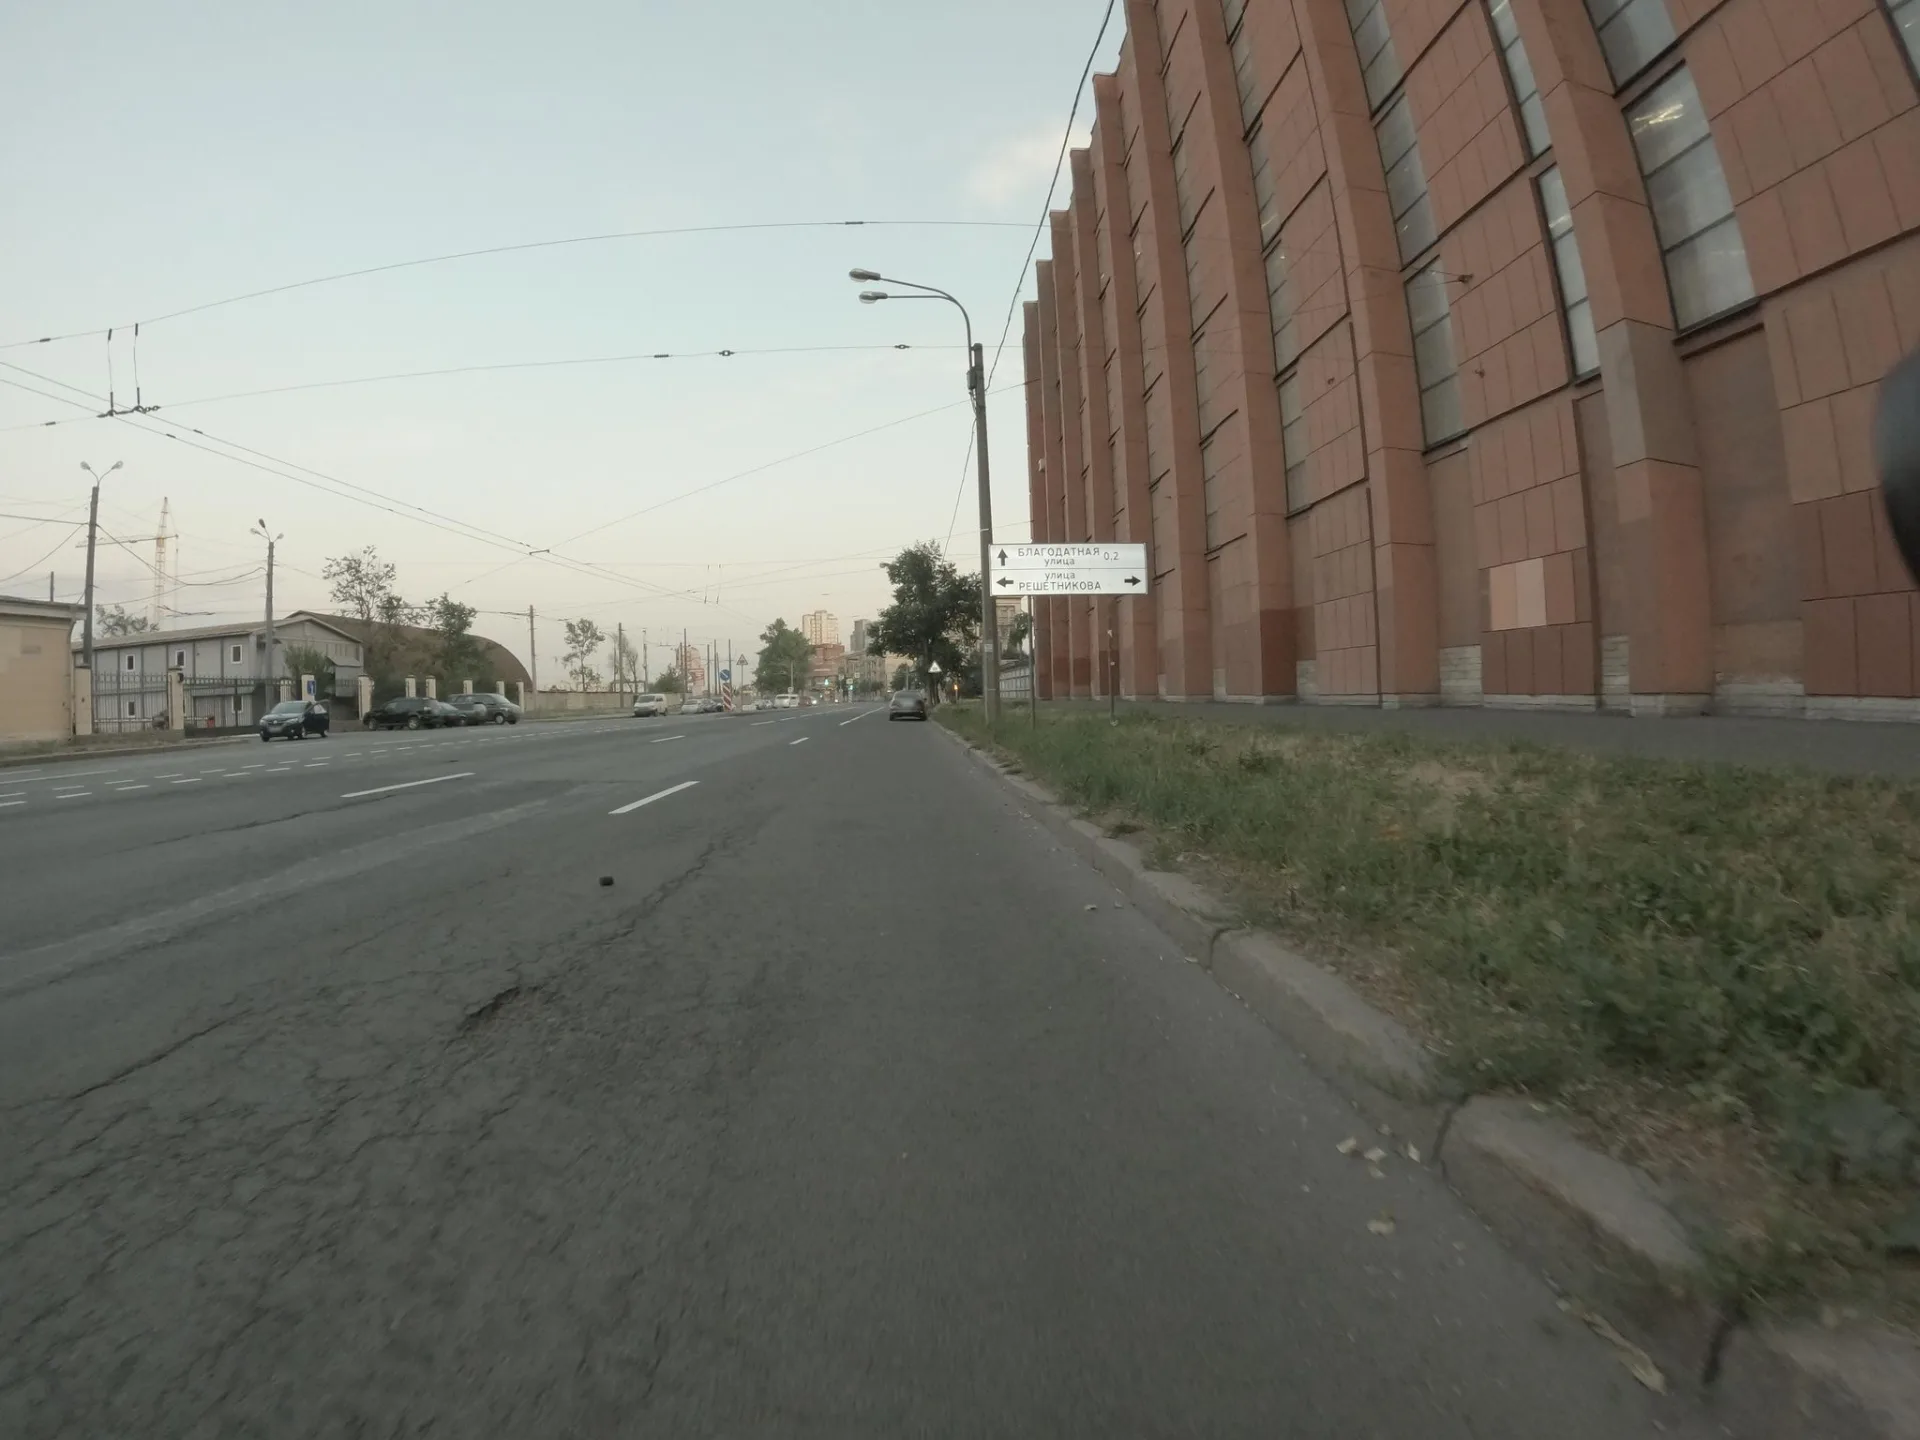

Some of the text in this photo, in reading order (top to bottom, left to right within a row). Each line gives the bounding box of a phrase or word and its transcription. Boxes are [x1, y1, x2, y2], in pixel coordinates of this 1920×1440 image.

[1018, 547, 1100, 557] БЛАГОДАТНАЯ
[1103, 552, 1120, 561] 0,2
[1044, 558, 1075, 566] улица
[1045, 572, 1076, 580] улица
[1018, 581, 1102, 591] РЕШЕТНИКОВА
